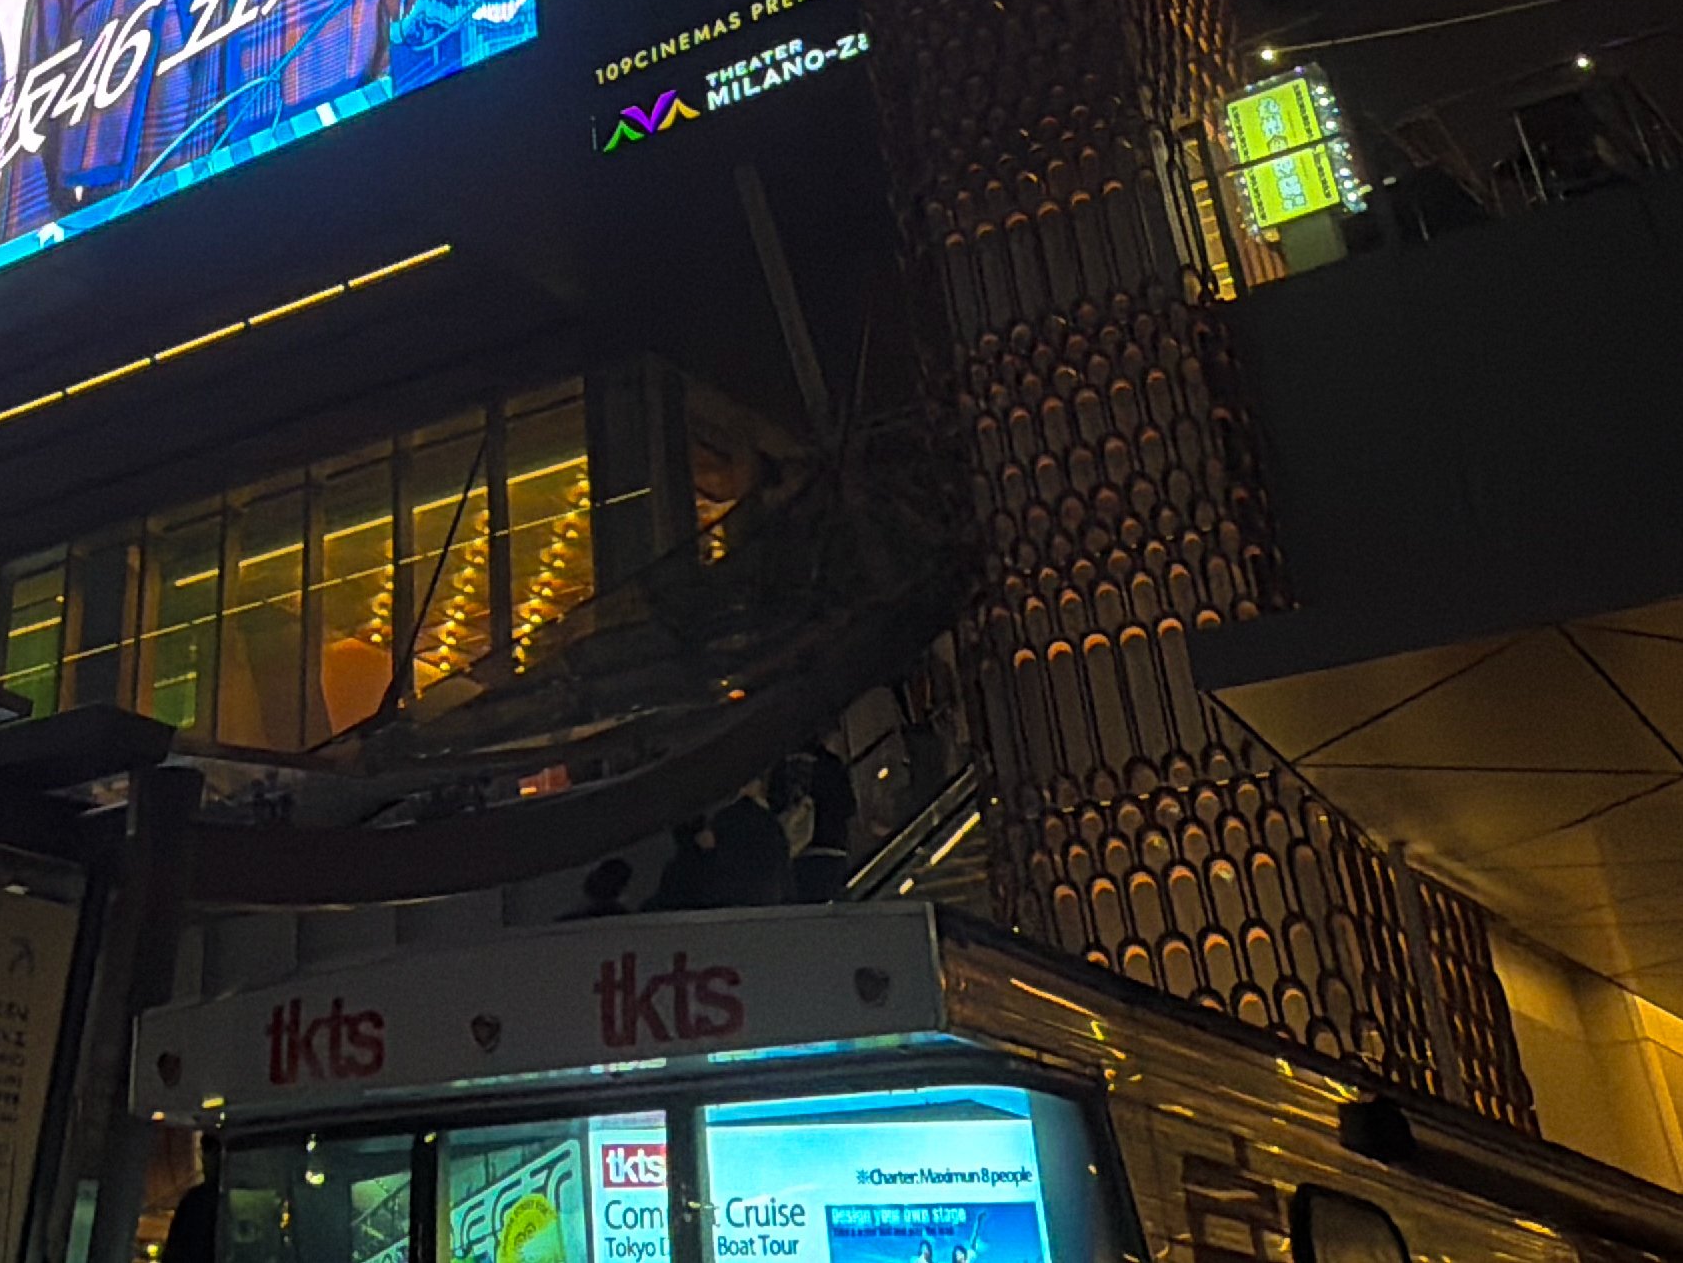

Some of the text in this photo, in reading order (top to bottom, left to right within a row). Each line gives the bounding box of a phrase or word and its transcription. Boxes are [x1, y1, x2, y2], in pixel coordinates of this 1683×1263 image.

[595, 11, 742, 86] 109CINEMAS
[705, 38, 804, 87] THEATER
[593, 951, 745, 1048] tkts
[266, 997, 385, 1085] tkts
[605, 1147, 667, 1185] tkts
[981, 1167, 990, 1183] 8
[991, 1165, 1033, 1188] people
[725, 1197, 806, 1229] Cruise
[604, 1236, 656, 1263] Tokyo
[717, 1236, 756, 1256] Boat
[761, 1235, 799, 1256] Tour
